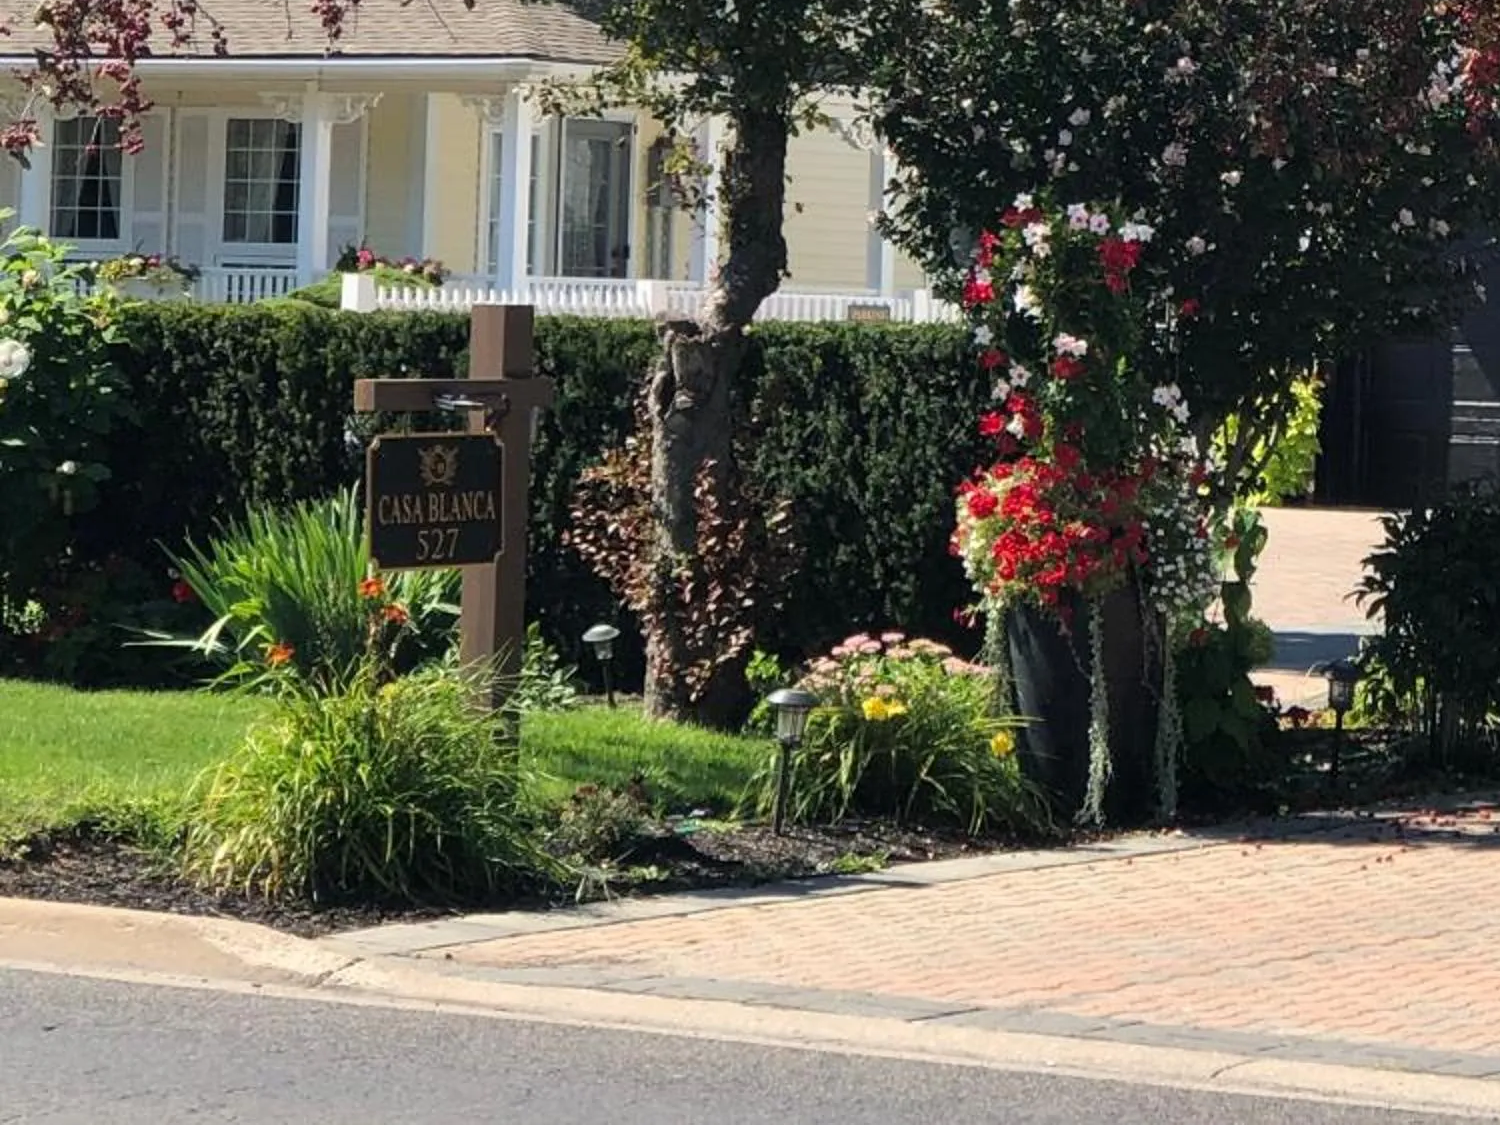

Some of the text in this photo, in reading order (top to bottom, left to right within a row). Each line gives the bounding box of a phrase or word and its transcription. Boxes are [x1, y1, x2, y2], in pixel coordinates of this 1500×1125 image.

[378, 490, 496, 525] CASA BLANCA
[415, 528, 459, 561] 527
